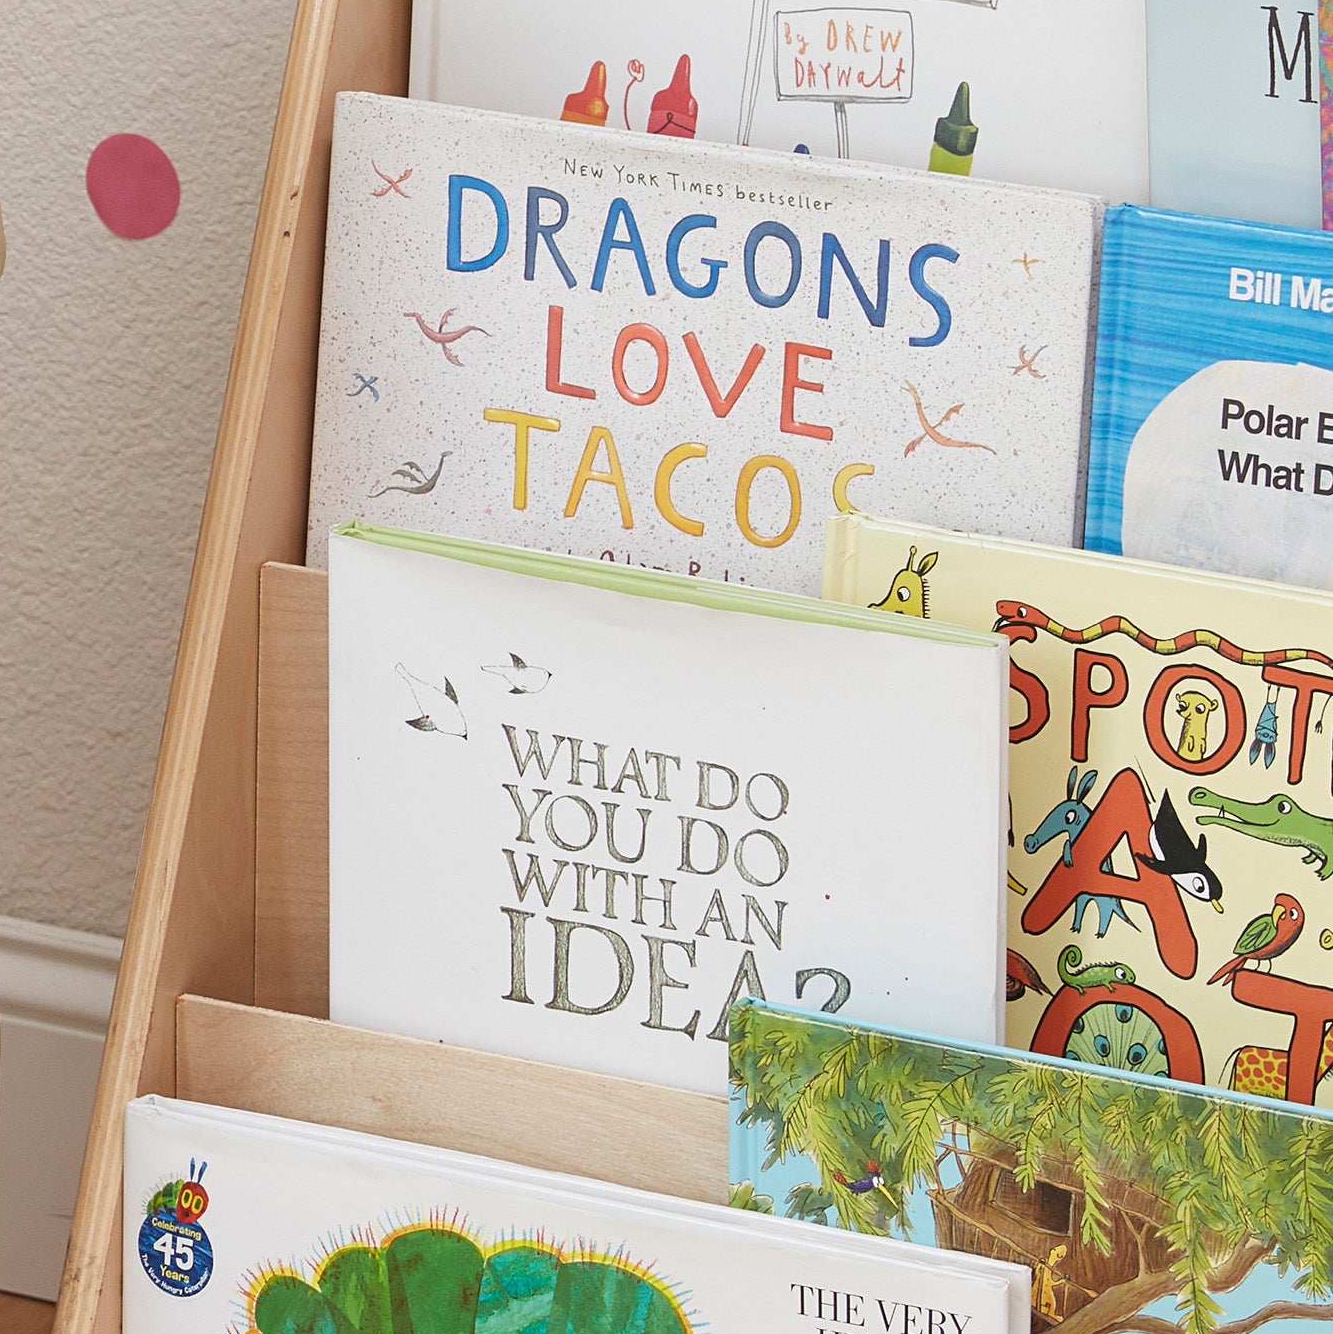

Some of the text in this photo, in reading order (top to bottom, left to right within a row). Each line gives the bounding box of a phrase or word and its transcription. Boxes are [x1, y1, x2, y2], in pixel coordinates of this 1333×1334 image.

[827, 19, 902, 53] DREW
[736, 185, 833, 211] bestseller
[446, 174, 961, 348] DRAGONS
[1229, 267, 1282, 306] Bill
[545, 304, 833, 441] LOVE
[1221, 398, 1309, 440] Polar
[1218, 448, 1305, 492] What
[501, 723, 789, 821] WHAT DO
[502, 783, 789, 887] YOU DO
[502, 848, 789, 951] WITH AN
[152, 1217, 202, 1241] Celebrating
[153, 1232, 193, 1270] 45
[160, 1264, 189, 1284] Years
[790, 1283, 865, 1327] THE
